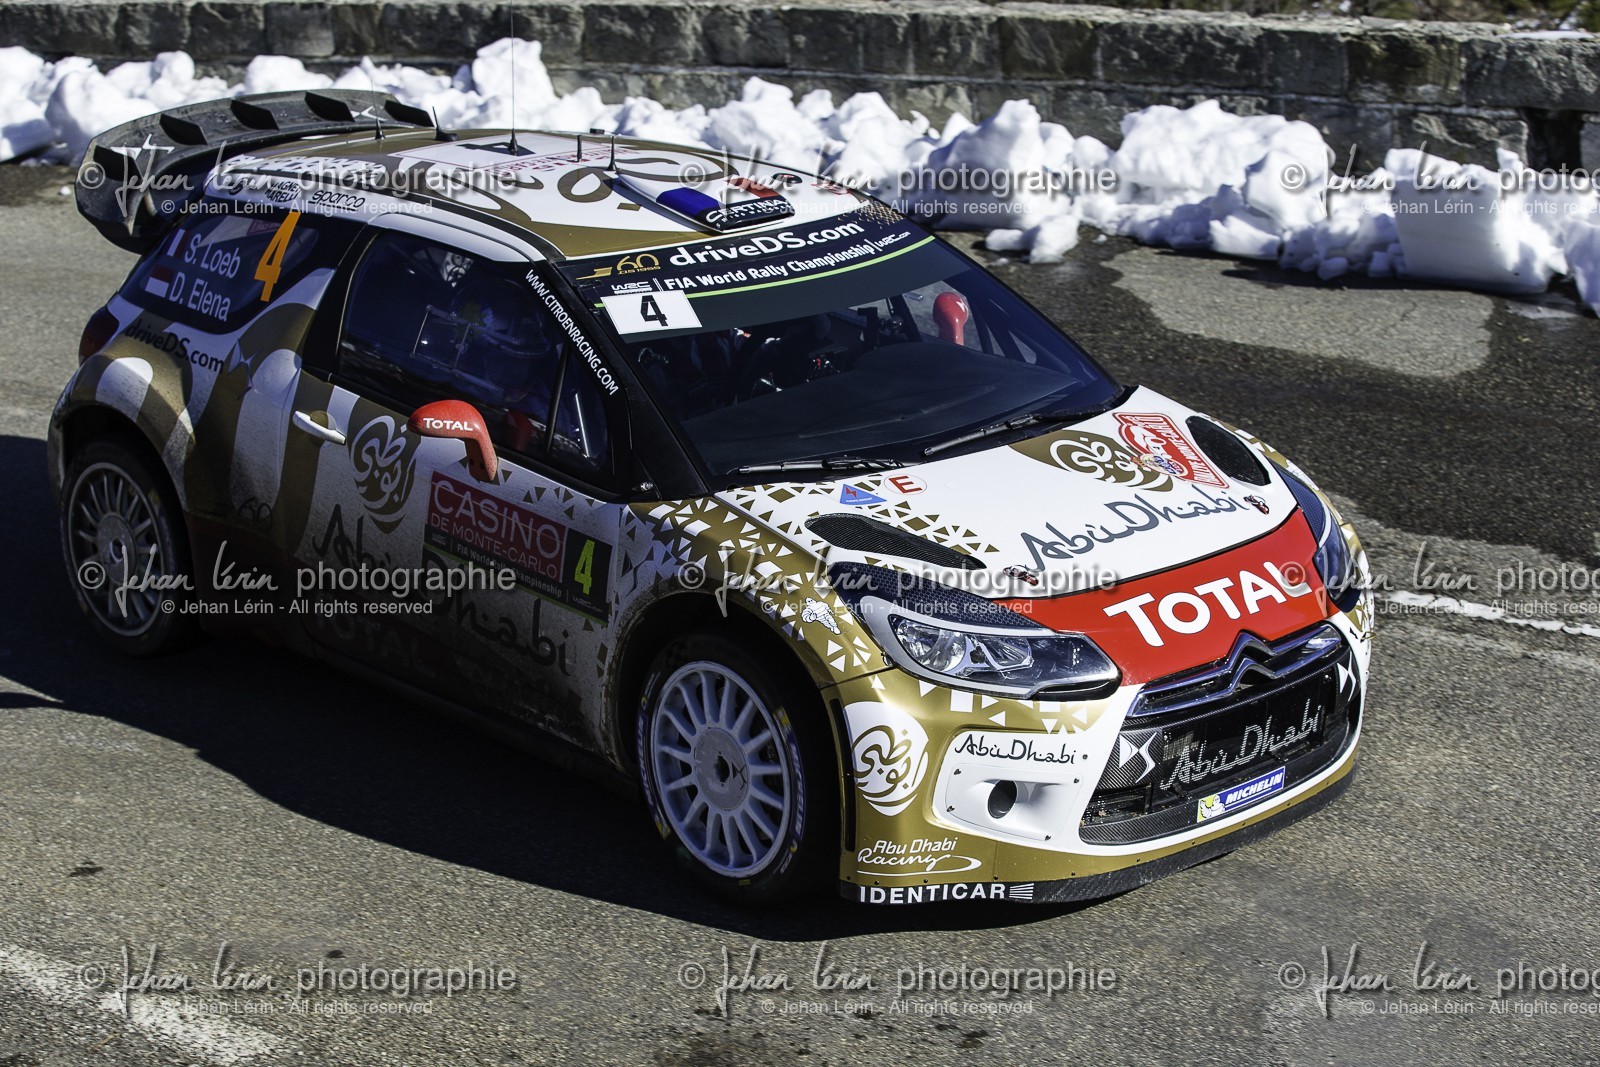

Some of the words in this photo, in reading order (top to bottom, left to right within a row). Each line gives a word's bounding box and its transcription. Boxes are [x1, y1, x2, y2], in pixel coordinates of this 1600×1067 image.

[311, 189, 366, 209] sparco
[184, 233, 199, 265] S.
[200, 241, 241, 279] Loeb
[254, 211, 301, 302] 4
[616, 253, 660, 271] 60
[669, 223, 866, 266] driveDS.com
[664, 278, 697, 291] FIA
[696, 269, 748, 286] World
[749, 262, 789, 280] Rally
[787, 242, 876, 273] Championship
[169, 271, 185, 305] D.
[187, 278, 231, 322] Elena
[639, 294, 669, 327] 4
[124, 317, 225, 374] driveDS.com
[525, 268, 620, 396] WWW.CITROENRACING.COM
[422, 417, 474, 432] TOTAL
[888, 475, 923, 493] E
[434, 480, 561, 560] CASINO
[430, 512, 450, 533] DE
[452, 521, 559, 580] MONTE-CARLO
[456, 543, 471, 558] FIA
[574, 539, 596, 596] 4
[1102, 560, 1313, 648] TOTAL
[1225, 771, 1284, 805] MICHELIN
[857, 847, 952, 872] Racing
[872, 839, 908, 856] Abu
[909, 837, 959, 855] Dhabi
[859, 882, 1006, 905] IDENTICAR
